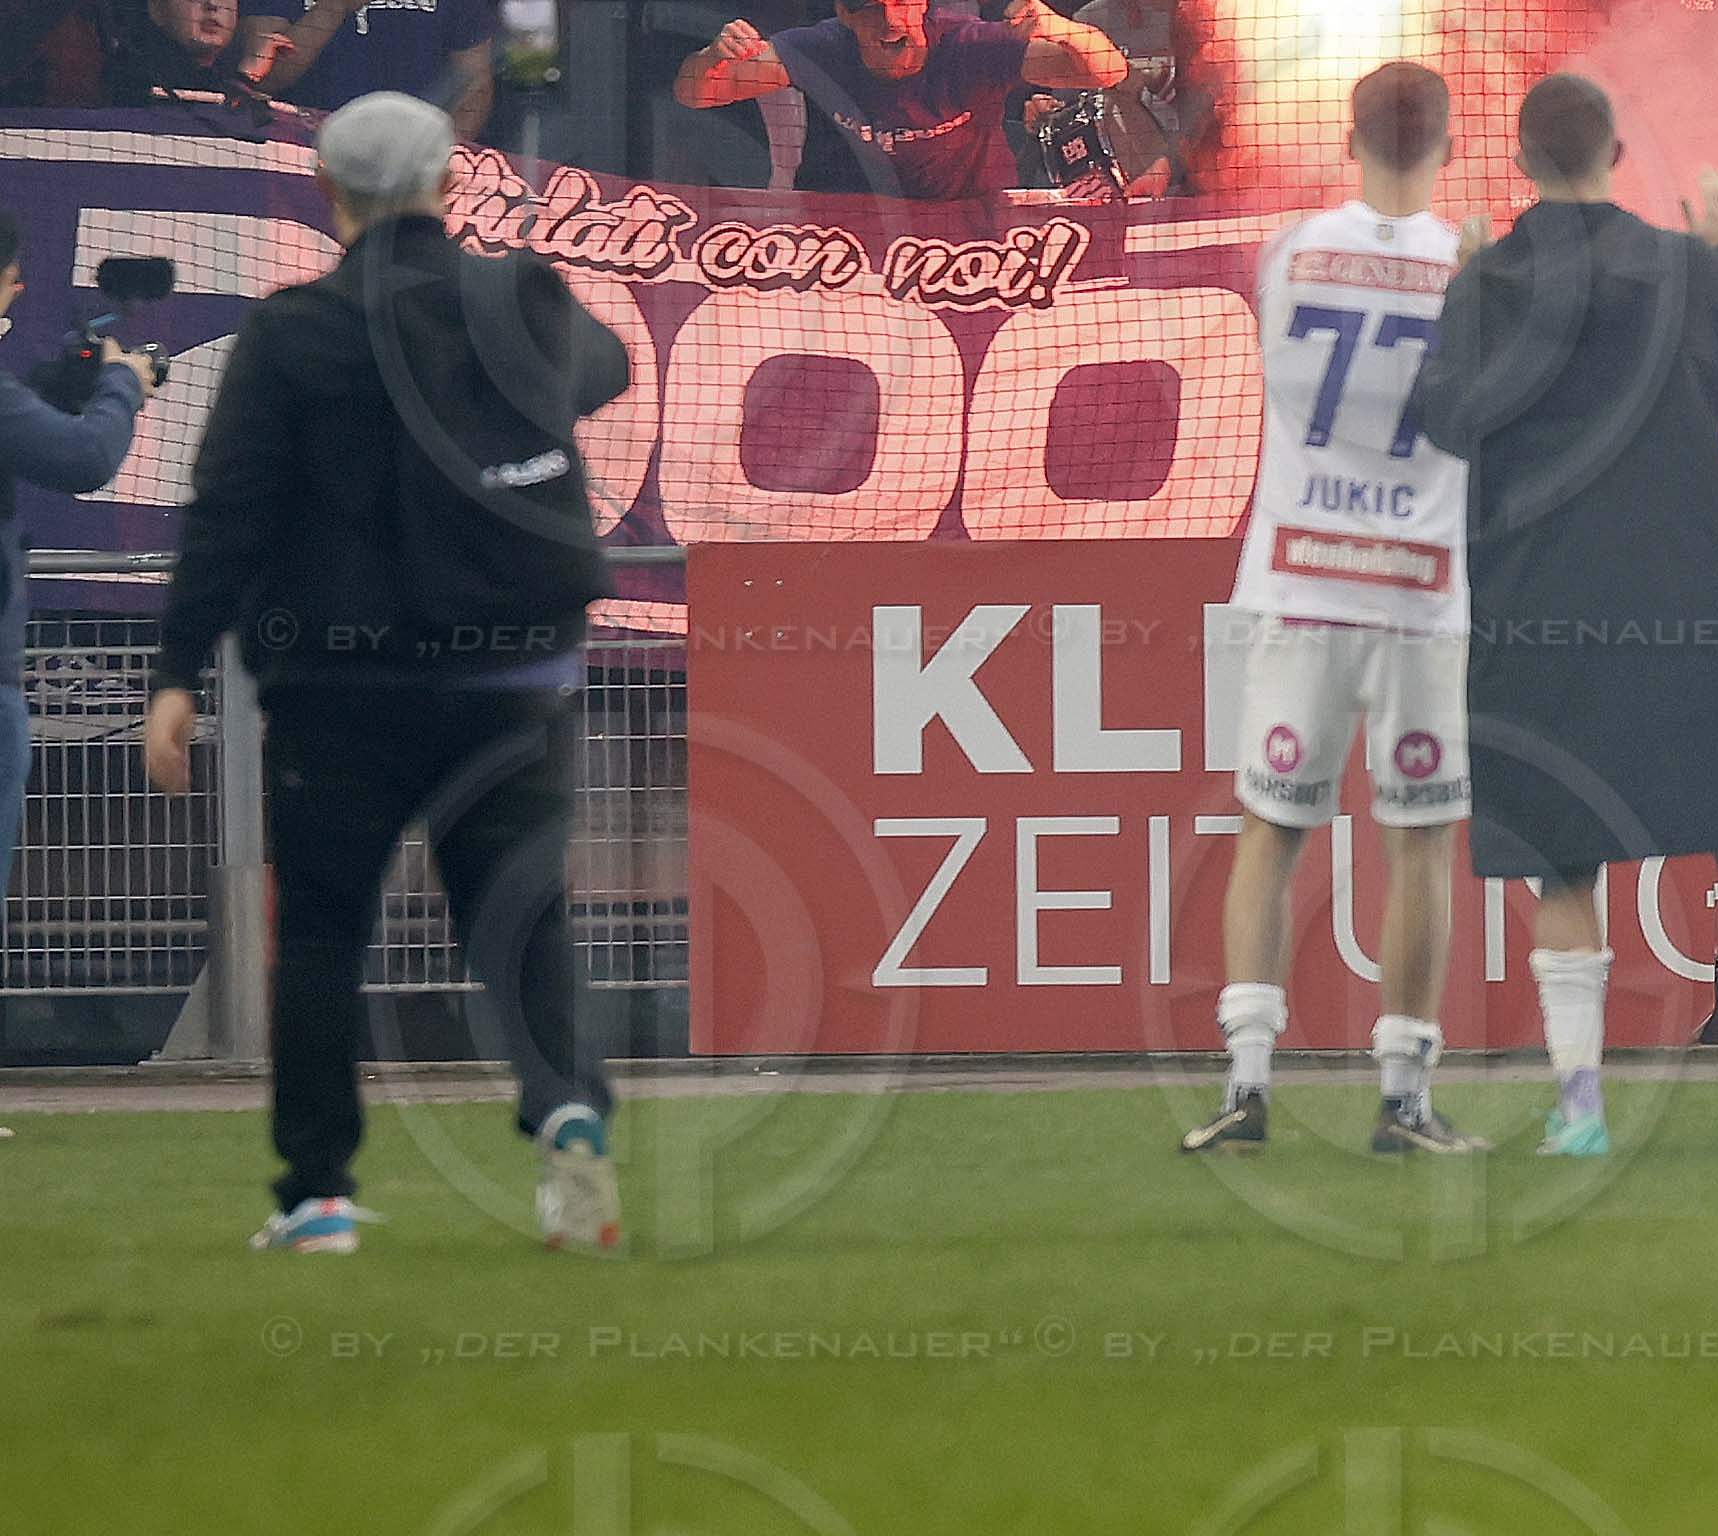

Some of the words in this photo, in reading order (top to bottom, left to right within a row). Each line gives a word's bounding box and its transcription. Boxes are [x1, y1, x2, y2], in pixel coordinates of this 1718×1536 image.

[702, 226, 862, 290] con
[890, 218, 1086, 310] noi!
[1297, 476, 1417, 520] JUKIC
